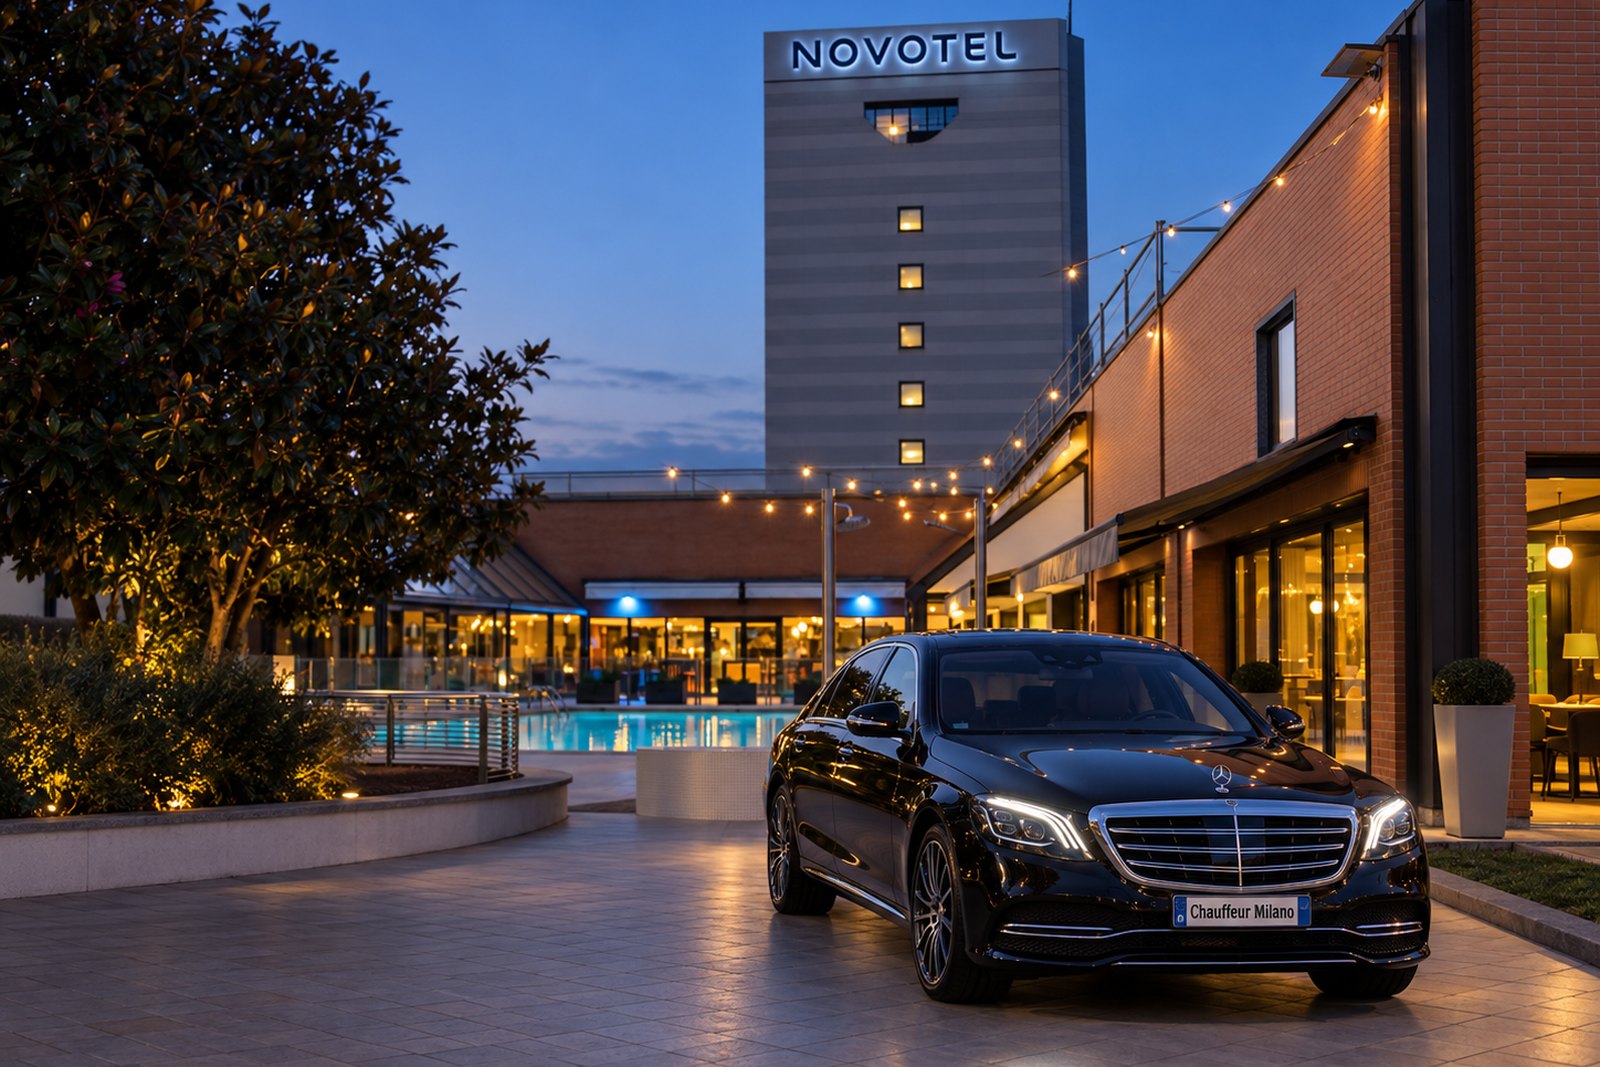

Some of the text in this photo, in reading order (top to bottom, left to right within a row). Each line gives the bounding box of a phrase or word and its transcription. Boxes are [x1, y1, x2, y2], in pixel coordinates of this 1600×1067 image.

[792, 30, 1017, 69] NOVOTEL
[1190, 903, 1251, 919] Chauffeur
[1254, 903, 1294, 919] Milano
